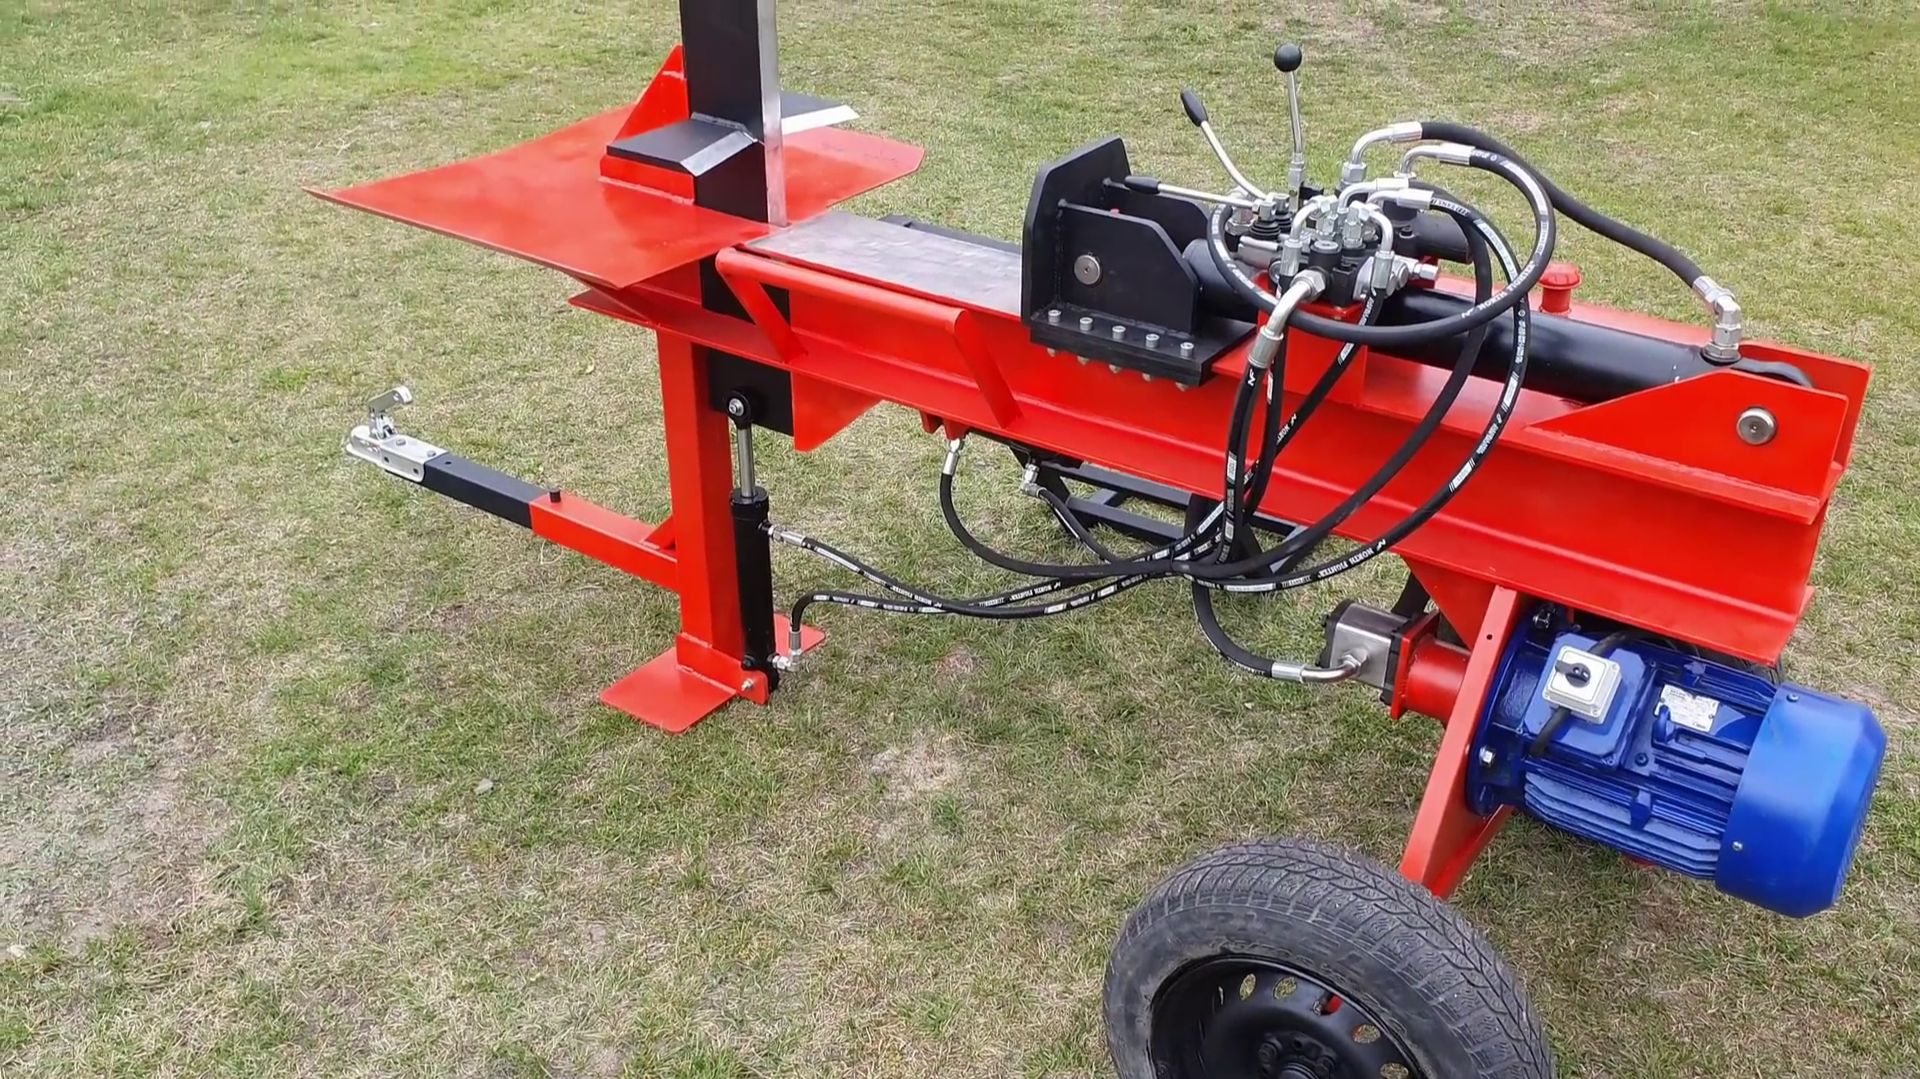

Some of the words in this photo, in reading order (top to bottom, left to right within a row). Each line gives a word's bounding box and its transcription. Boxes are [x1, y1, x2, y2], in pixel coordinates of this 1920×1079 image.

[1478, 291, 1508, 311] NORTH
[1507, 261, 1536, 291] FIGHTER
[1277, 424, 1290, 445] NORT
[1349, 547, 1375, 565] NORTH
[1319, 560, 1348, 578] FIGHTER
[1033, 584, 1053, 595] NORTH
